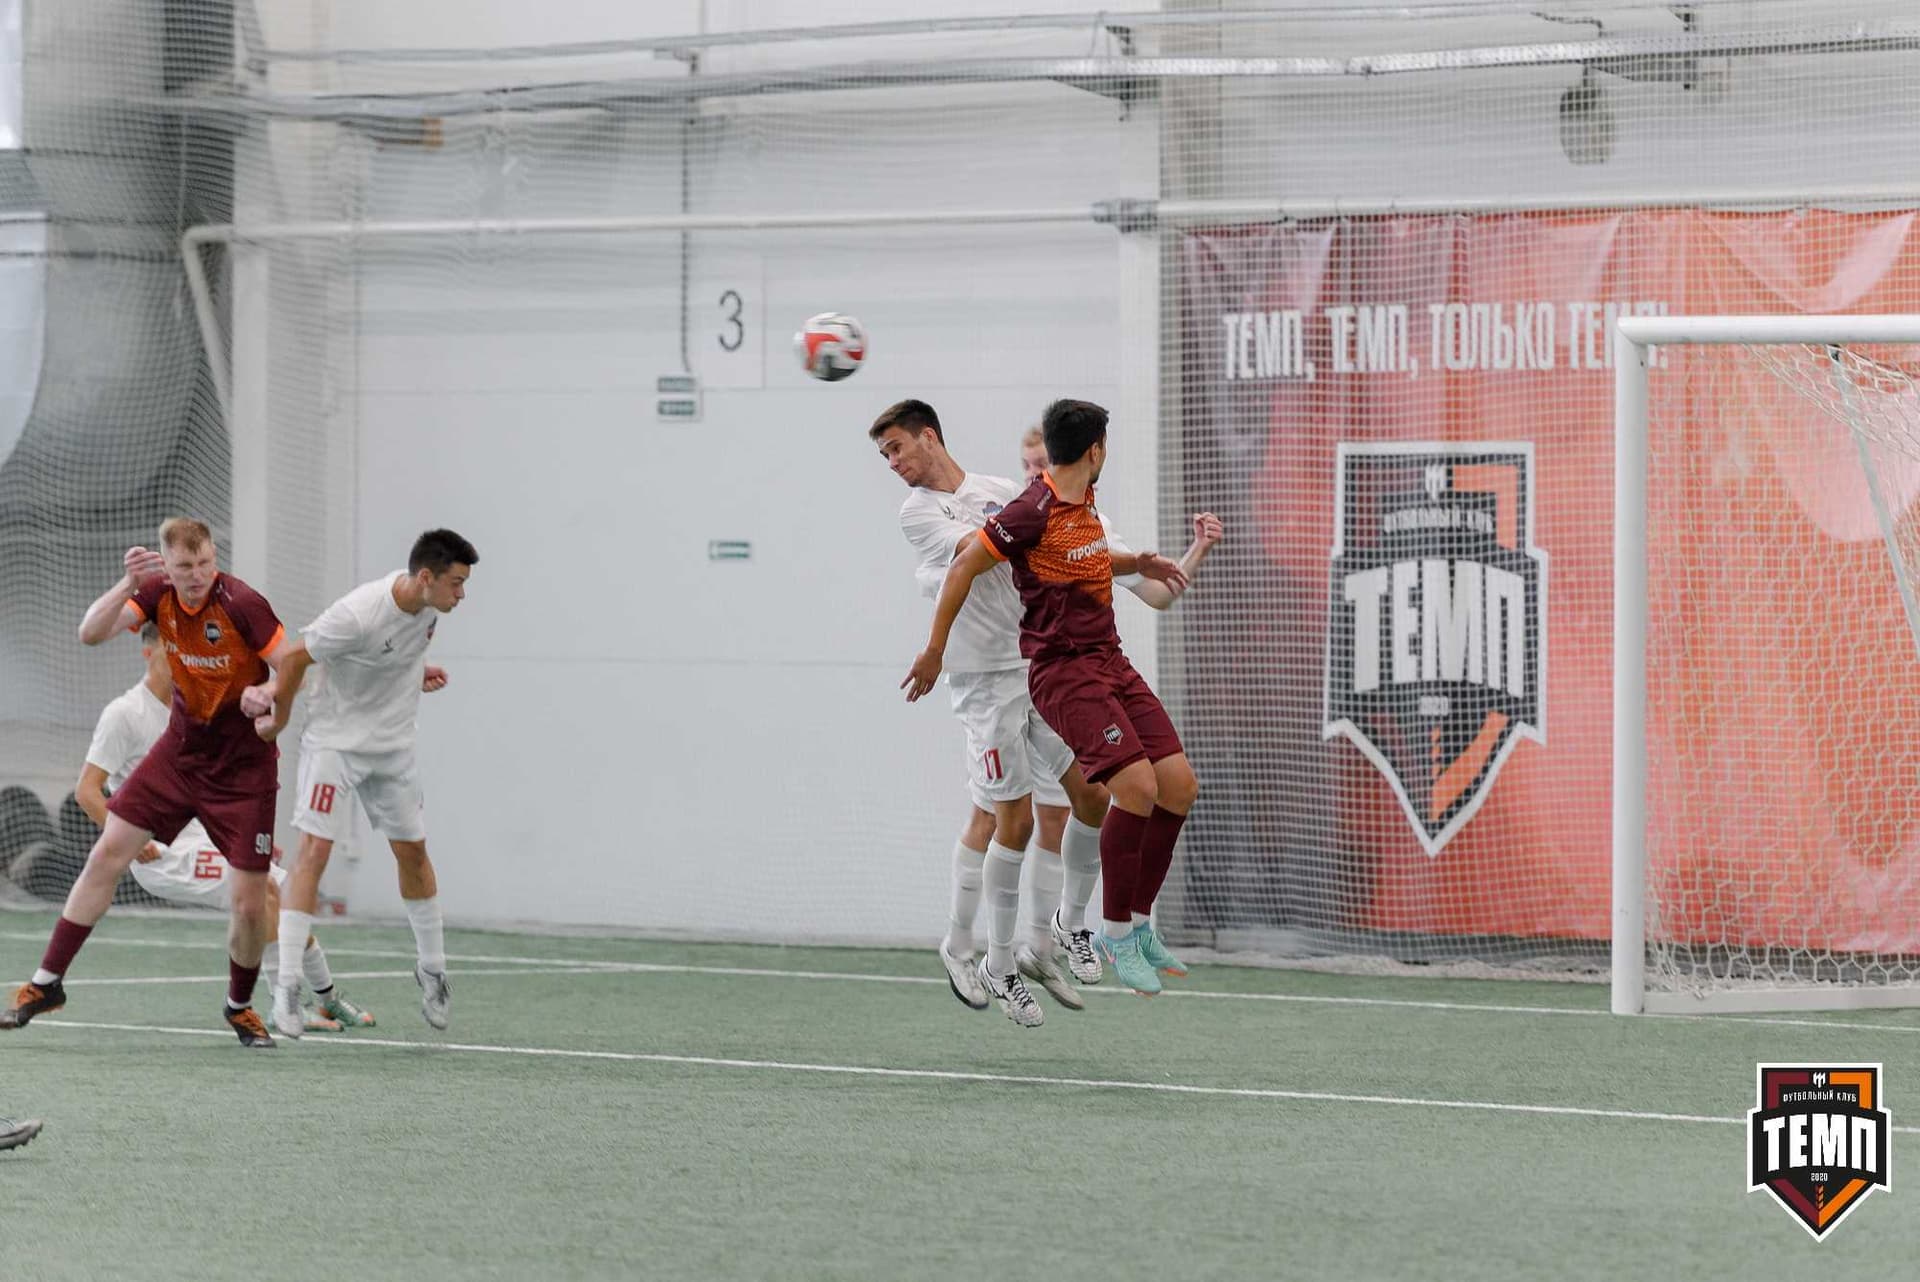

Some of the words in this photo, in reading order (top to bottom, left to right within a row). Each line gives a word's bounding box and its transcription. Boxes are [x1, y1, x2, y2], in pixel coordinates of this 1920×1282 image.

[719, 289, 743, 352] 3
[1222, 310, 1316, 383] ТЕМП,
[1324, 305, 1419, 380] ТЕМП,
[1429, 302, 1555, 370] ТОЛЬКО
[1345, 559, 1525, 699] ТЕМП
[310, 783, 336, 814] 18
[255, 832, 272, 855] 90
